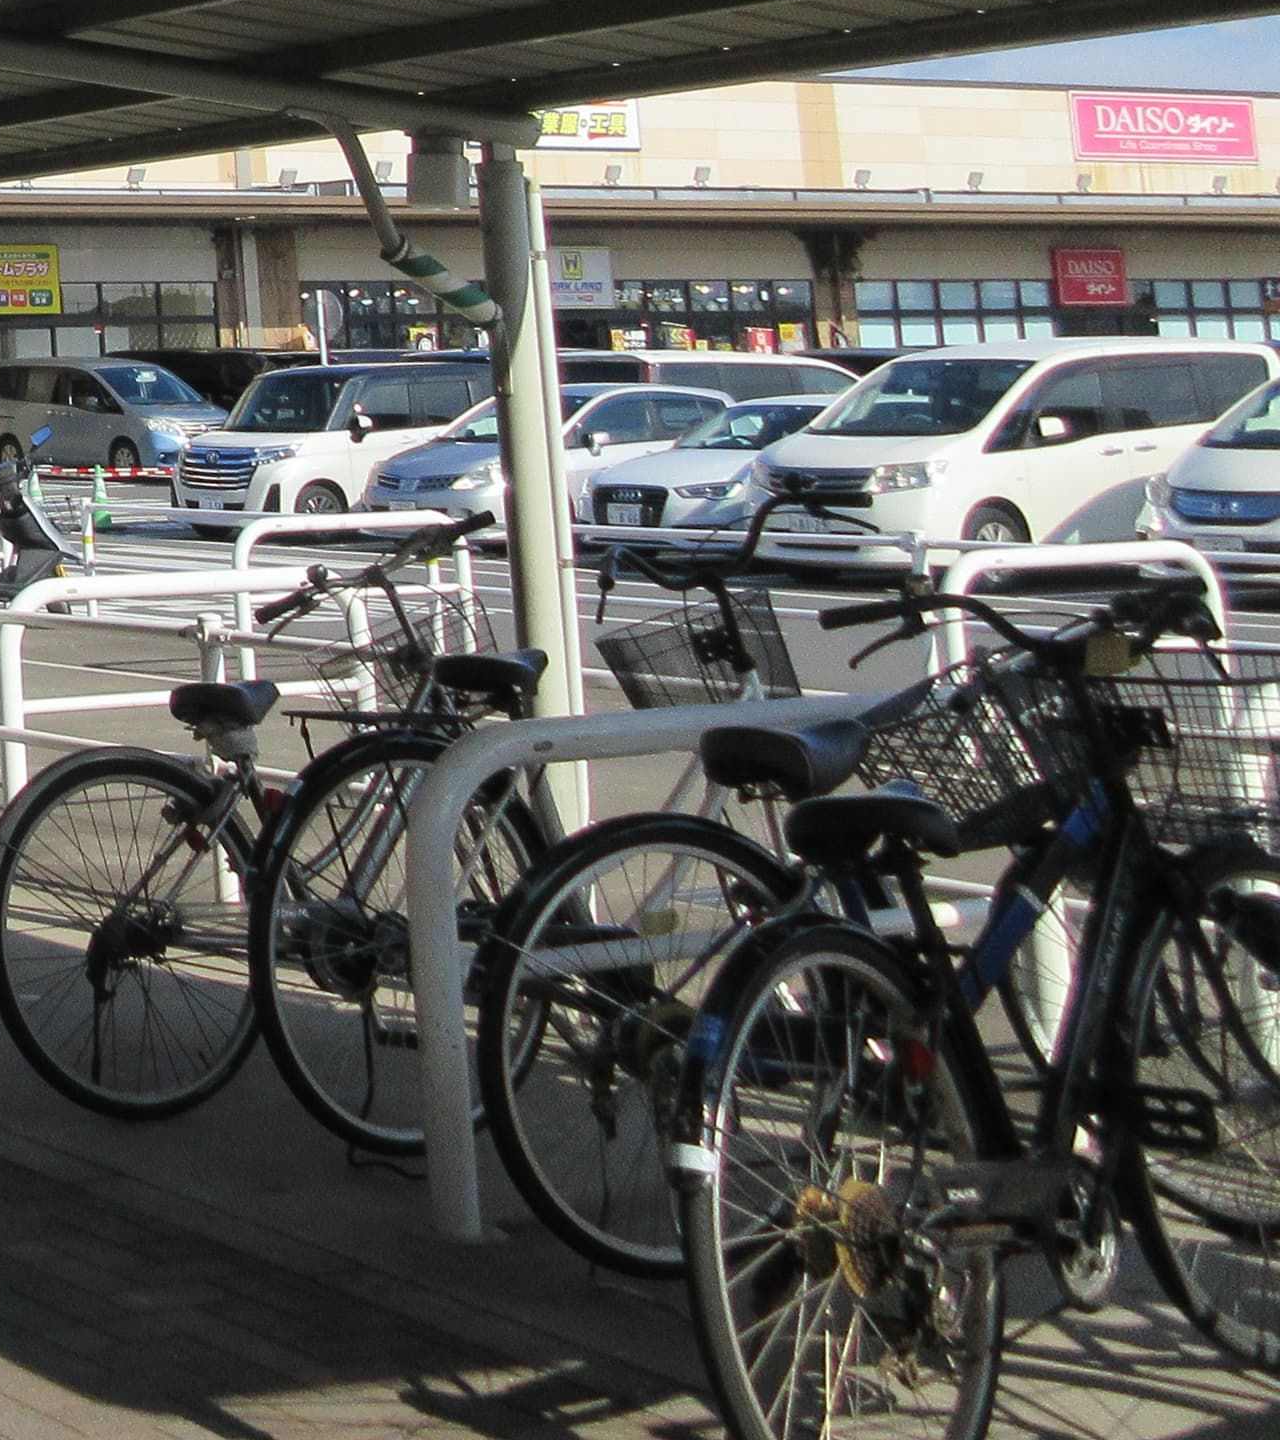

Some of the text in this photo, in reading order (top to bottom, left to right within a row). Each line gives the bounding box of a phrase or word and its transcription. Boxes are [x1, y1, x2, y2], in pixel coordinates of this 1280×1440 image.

[528, 110, 626, 136] 業服・工具
[1094, 104, 1184, 134] DAISO
[1186, 113, 1236, 134] ダイソー
[1067, 260, 1115, 275] DAISO
